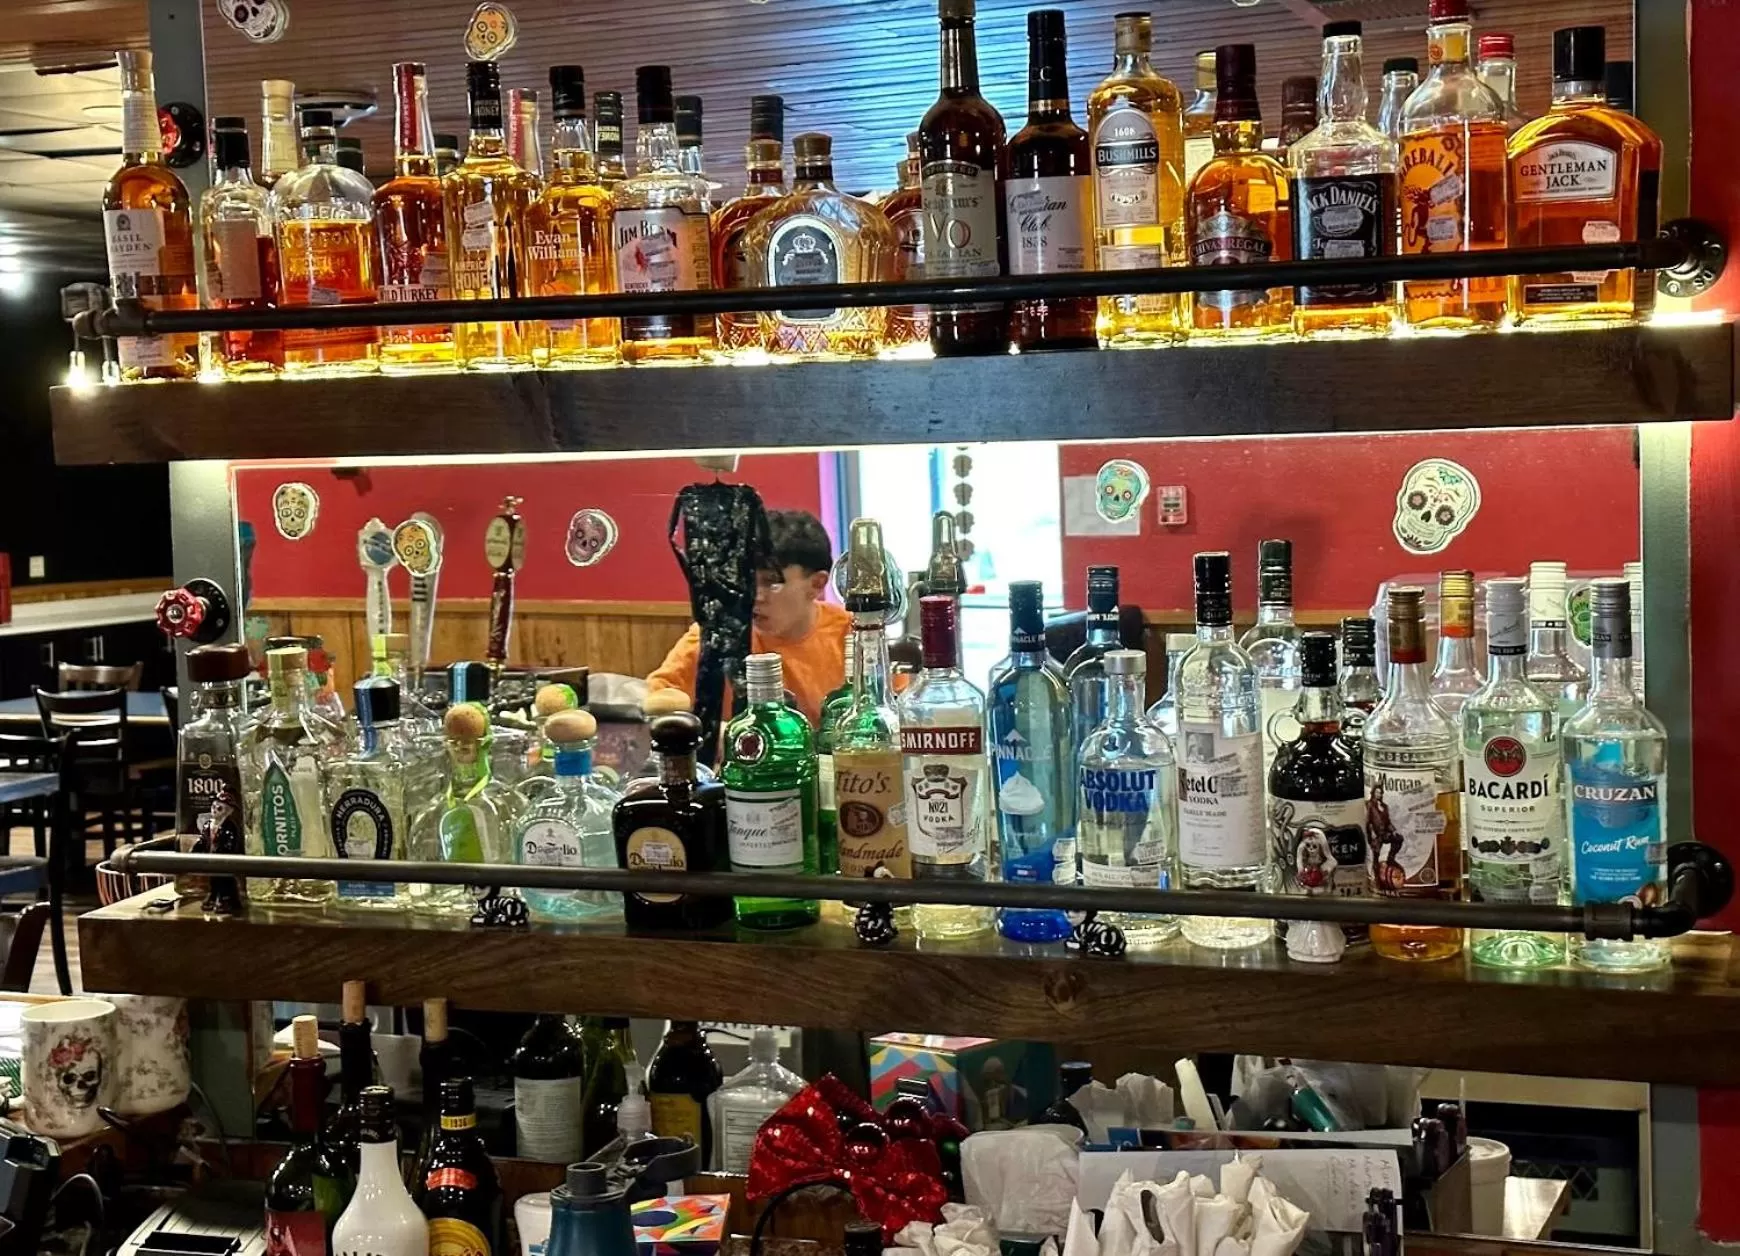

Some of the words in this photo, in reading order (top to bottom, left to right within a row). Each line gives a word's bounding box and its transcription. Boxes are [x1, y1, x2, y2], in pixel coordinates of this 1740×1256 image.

[1097, 147, 1157, 163] BUSHMILLS
[1520, 160, 1607, 177] GENTLEMAN
[1546, 174, 1581, 189] JACK
[1330, 185, 1379, 215] DANIEL'S
[534, 230, 572, 245] Evan
[617, 226, 637, 250] JIM
[1227, 238, 1267, 254] REGAL
[528, 245, 586, 261] Williams
[187, 778, 224, 795] 1800
[1080, 769, 1157, 792] ABSOLUT
[1469, 773, 1549, 800] BACARDÍ
[1189, 796, 1220, 805] VODKA
[1574, 784, 1655, 801] CRUZAN
[335, 796, 386, 821] HERRADURA
[1083, 790, 1149, 814] VODKA
[1480, 804, 1536, 813] SUPERIOR
[271, 784, 289, 856] ORNITOS
[923, 815, 955, 824] VODKA
[1581, 839, 1622, 855] Coconut
